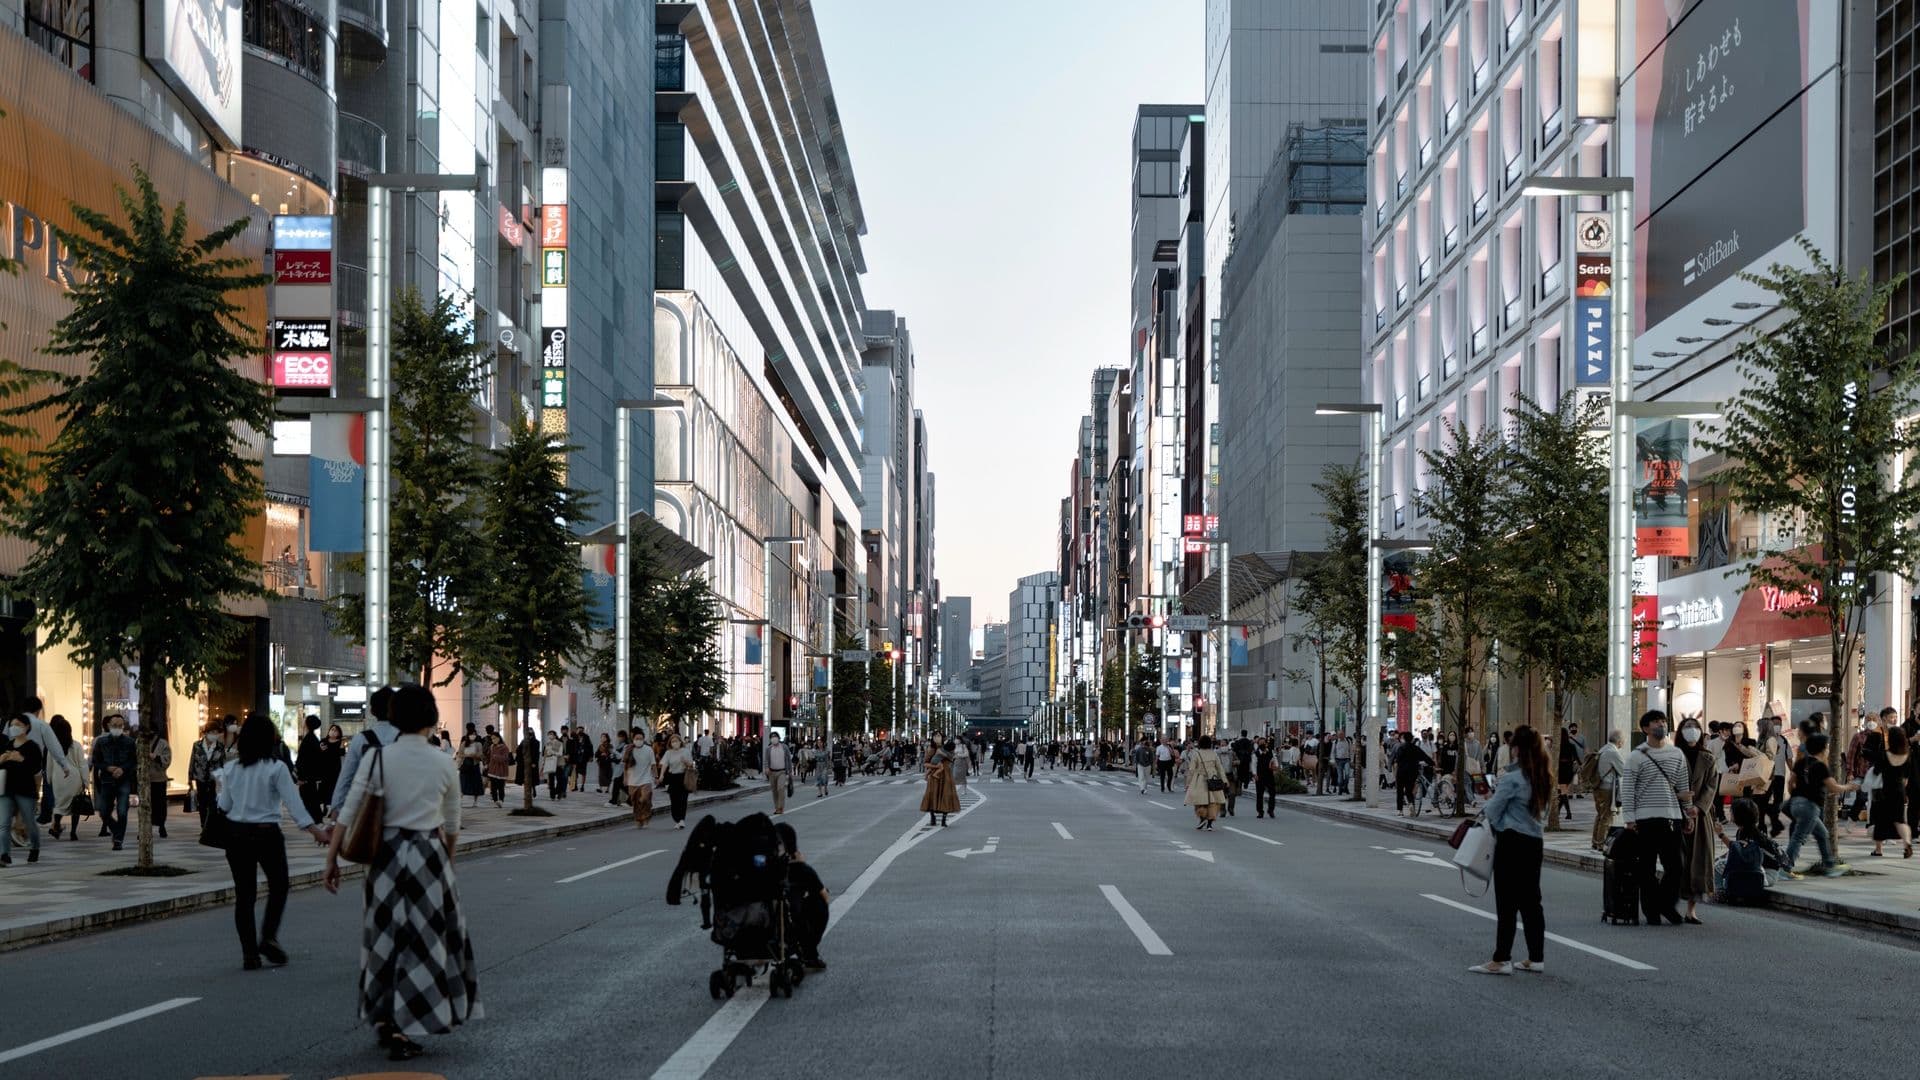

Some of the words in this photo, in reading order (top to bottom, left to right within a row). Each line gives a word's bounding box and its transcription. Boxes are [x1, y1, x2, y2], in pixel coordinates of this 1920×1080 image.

[1686, 17, 1741, 92] しあわせも
[1684, 75, 1735, 138] 貯まるよ。
[546, 206, 564, 240] まつげ
[286, 261, 320, 270] レディース
[546, 251, 563, 284] 歯科
[1578, 263, 1612, 275] Seria
[1696, 229, 1740, 277] SoftBank
[277, 270, 330, 279] アートネイチャー
[551, 329, 565, 367] Oasis
[1587, 307, 1603, 377] PLAZA
[285, 356, 329, 374] ECC
[323, 461, 361, 470] AUTUMN
[1677, 597, 1723, 629] SoftBank
